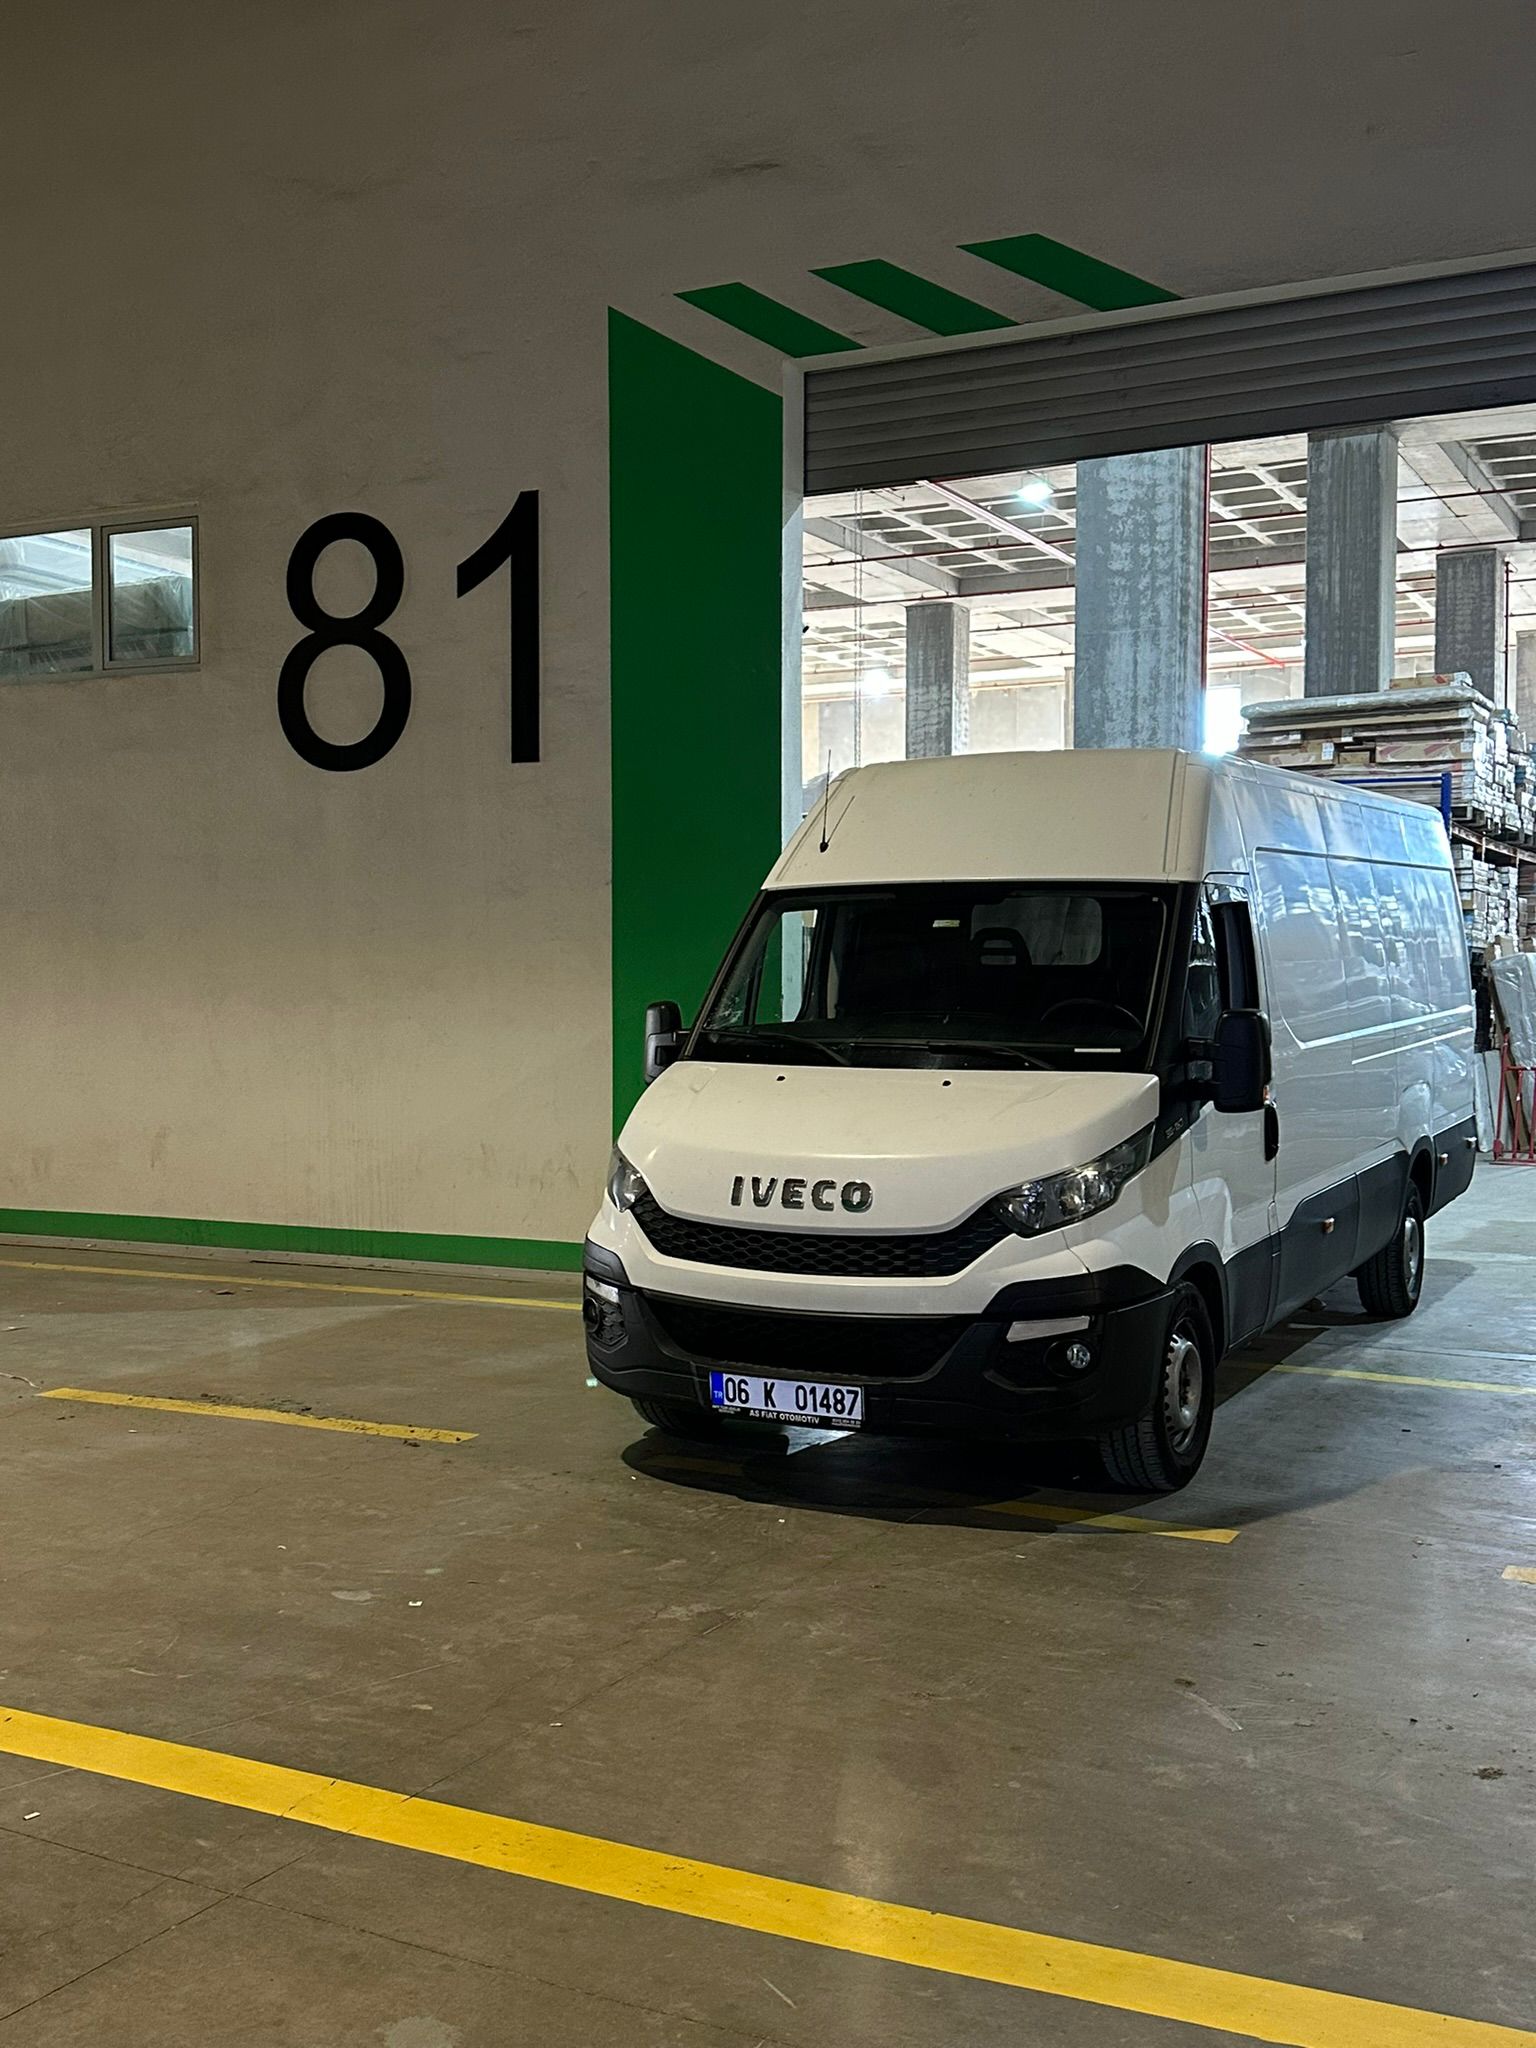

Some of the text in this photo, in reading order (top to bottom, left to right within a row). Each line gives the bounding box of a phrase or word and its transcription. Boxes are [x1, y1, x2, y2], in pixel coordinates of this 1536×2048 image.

[277, 489, 540, 772] 81
[731, 1175, 873, 1213] IVECO
[713, 1391, 723, 1399] TR
[724, 1377, 859, 1416] 06 K 01487
[749, 1409, 760, 1418] AS
